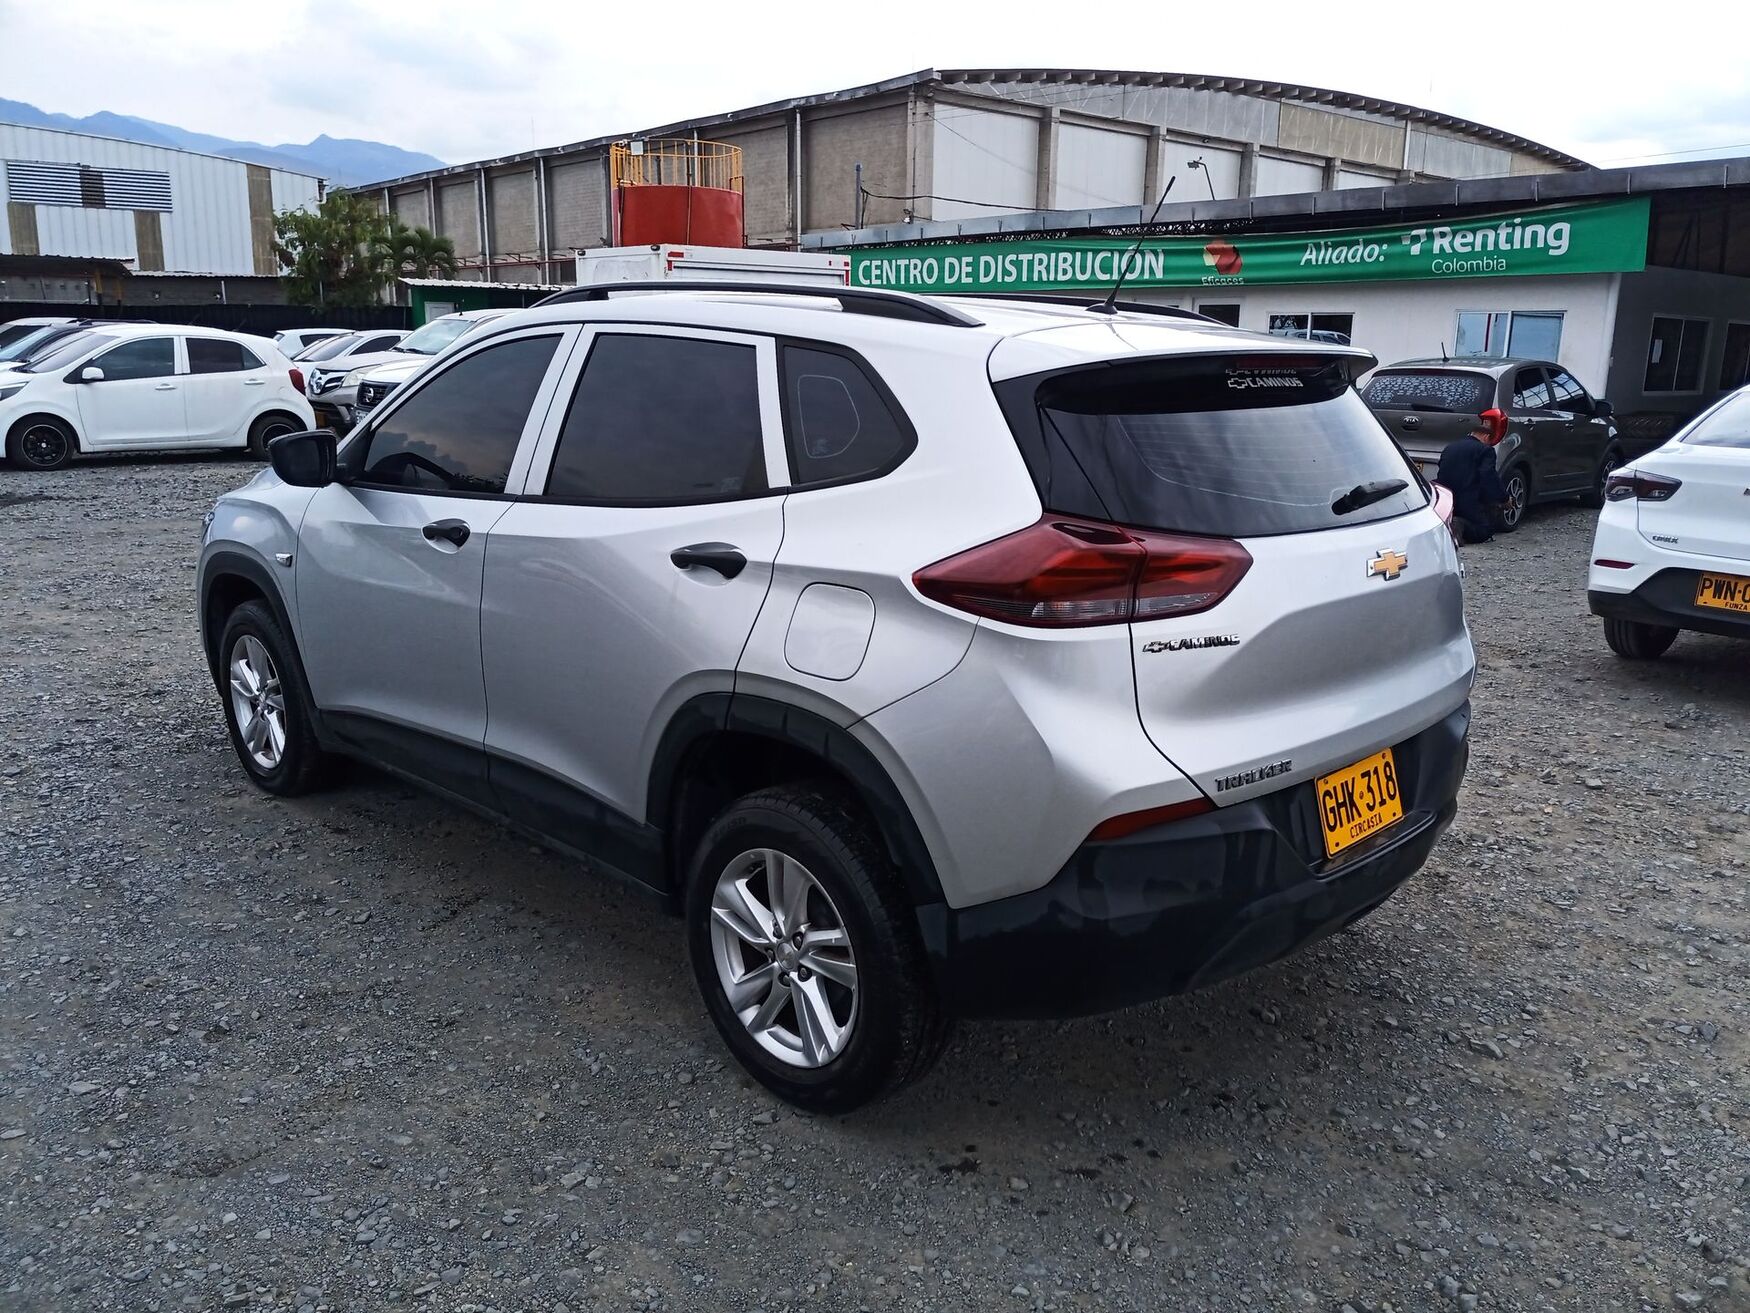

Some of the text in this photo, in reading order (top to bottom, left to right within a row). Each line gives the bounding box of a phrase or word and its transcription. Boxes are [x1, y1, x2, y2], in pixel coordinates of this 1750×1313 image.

[1432, 217, 1571, 256] Renting
[1300, 239, 1388, 267] Aliado:
[857, 245, 1165, 286] CENTRO DE DISTRIBUCIÓN
[1431, 256, 1506, 274] Colombia
[1201, 276, 1245, 286] Eficaces
[1246, 377, 1304, 388] CAMINOS
[1724, 601, 1748, 611] FUNZA
[1350, 812, 1383, 839] CIRCASIA
